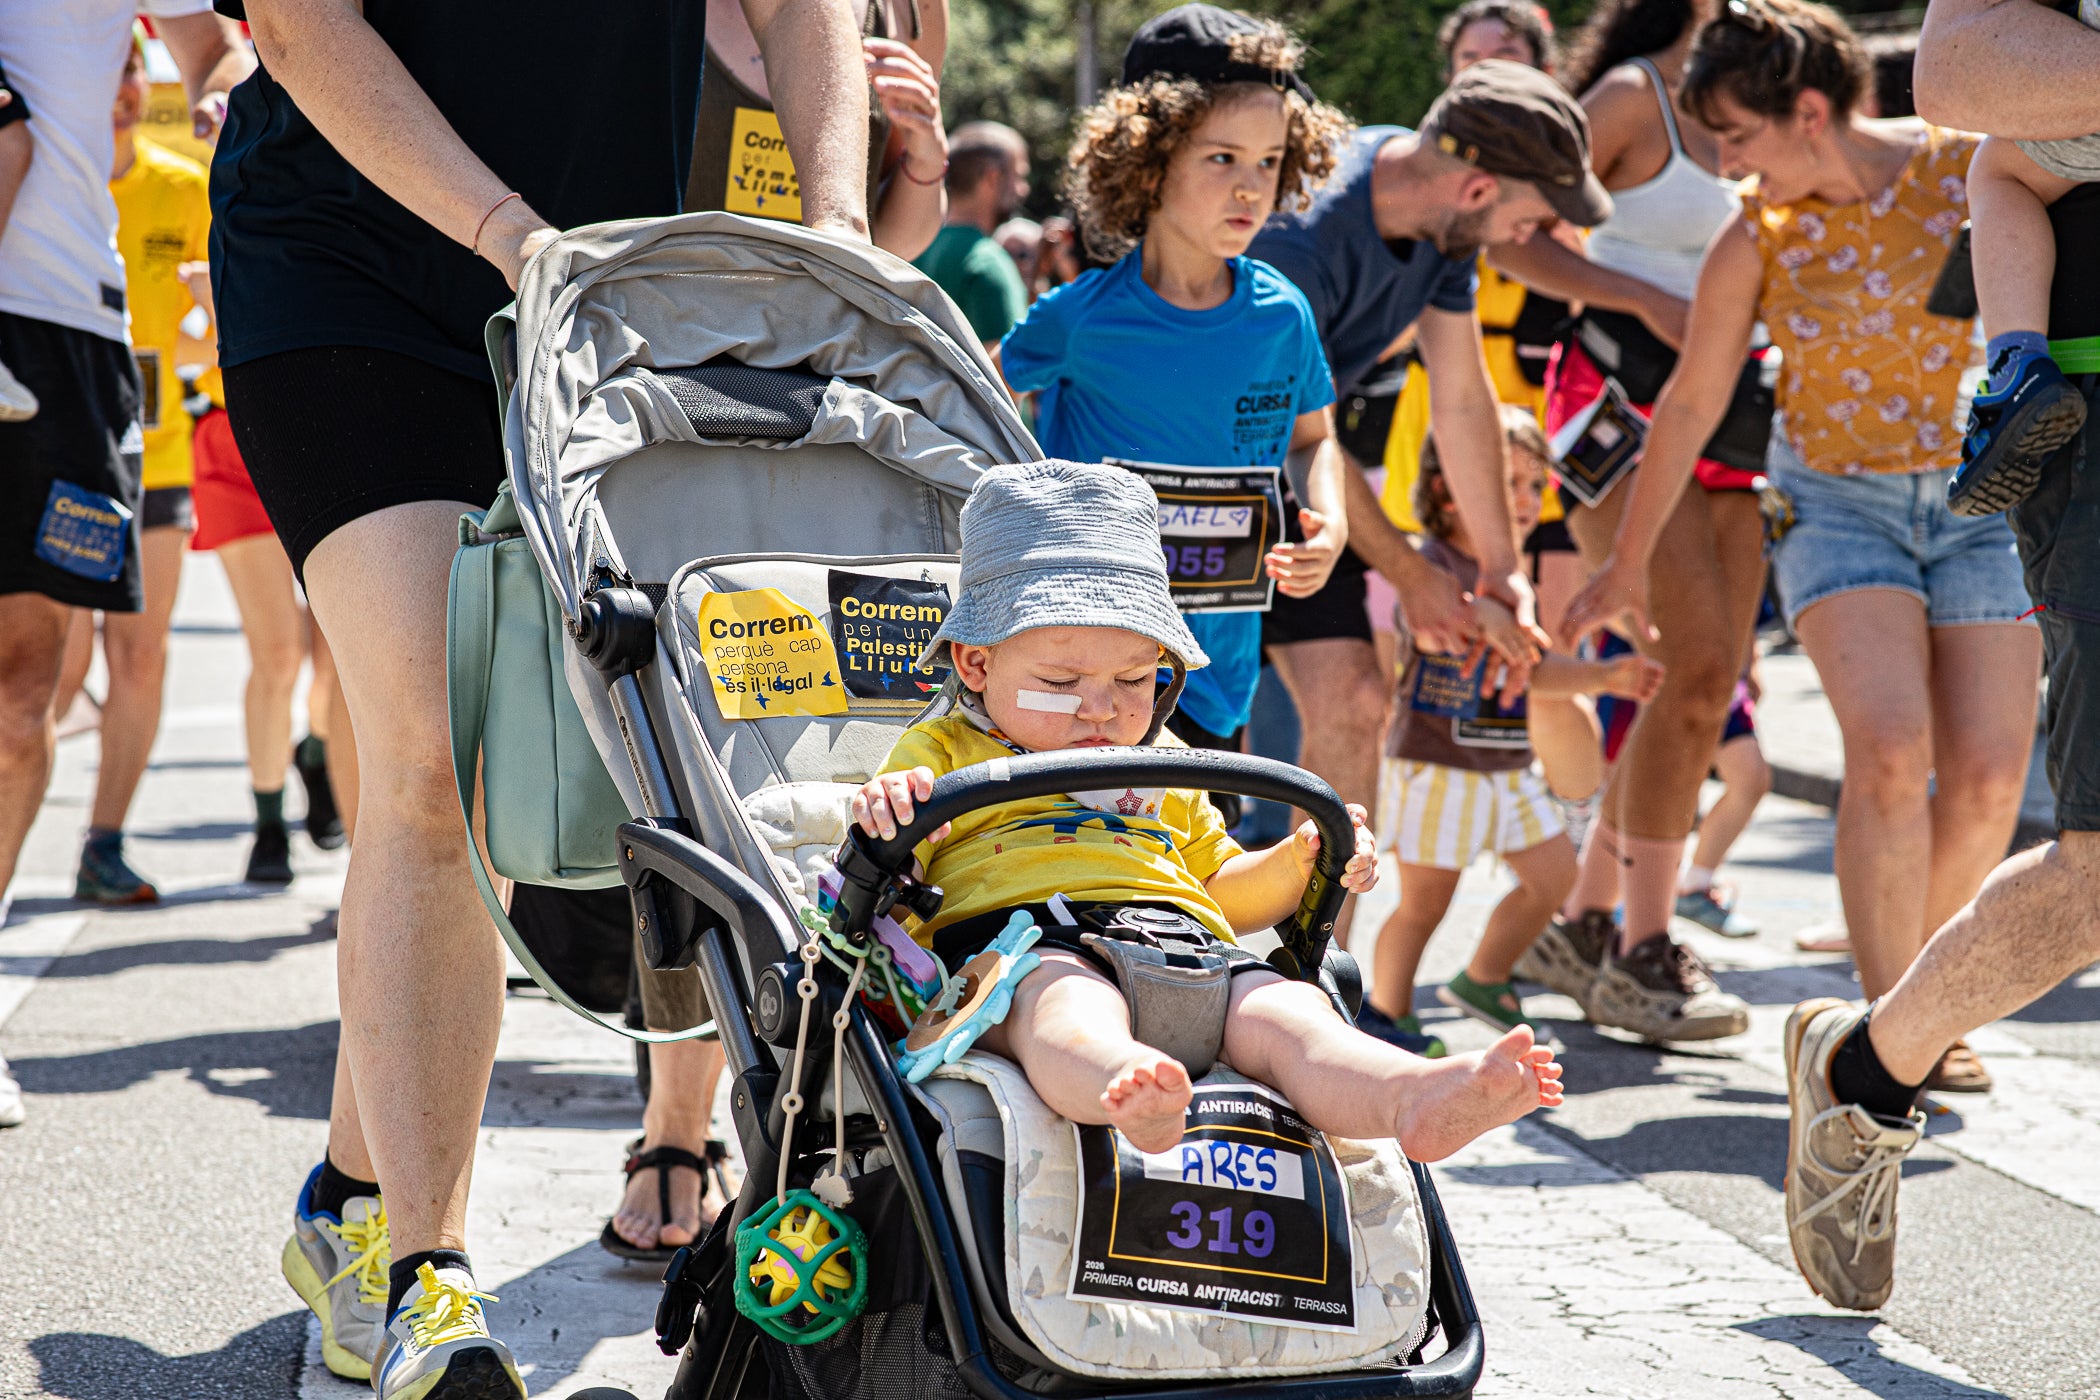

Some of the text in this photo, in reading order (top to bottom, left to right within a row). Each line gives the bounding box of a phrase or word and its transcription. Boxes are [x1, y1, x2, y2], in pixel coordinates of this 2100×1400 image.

[744, 131, 785, 151] Corr
[742, 163, 798, 183] Yeme
[1235, 393, 1291, 415] CURSA
[841, 596, 942, 623] Correm
[709, 614, 814, 639] Correm
[843, 622, 932, 640] per un
[714, 637, 822, 660] perquè cap
[847, 637, 928, 657] Palesti
[720, 660, 790, 676] persona
[849, 655, 934, 676] Lliure
[725, 677, 747, 693] és
[1197, 1100, 1276, 1121] ANTIRACIST
[1182, 1139, 1278, 1192] ARES
[1166, 1200, 1276, 1258] 319
[1082, 1271, 1134, 1288] PRIMERA
[1136, 1277, 1189, 1297] CURSA
[1293, 1296, 1348, 1315] TERRASSA
